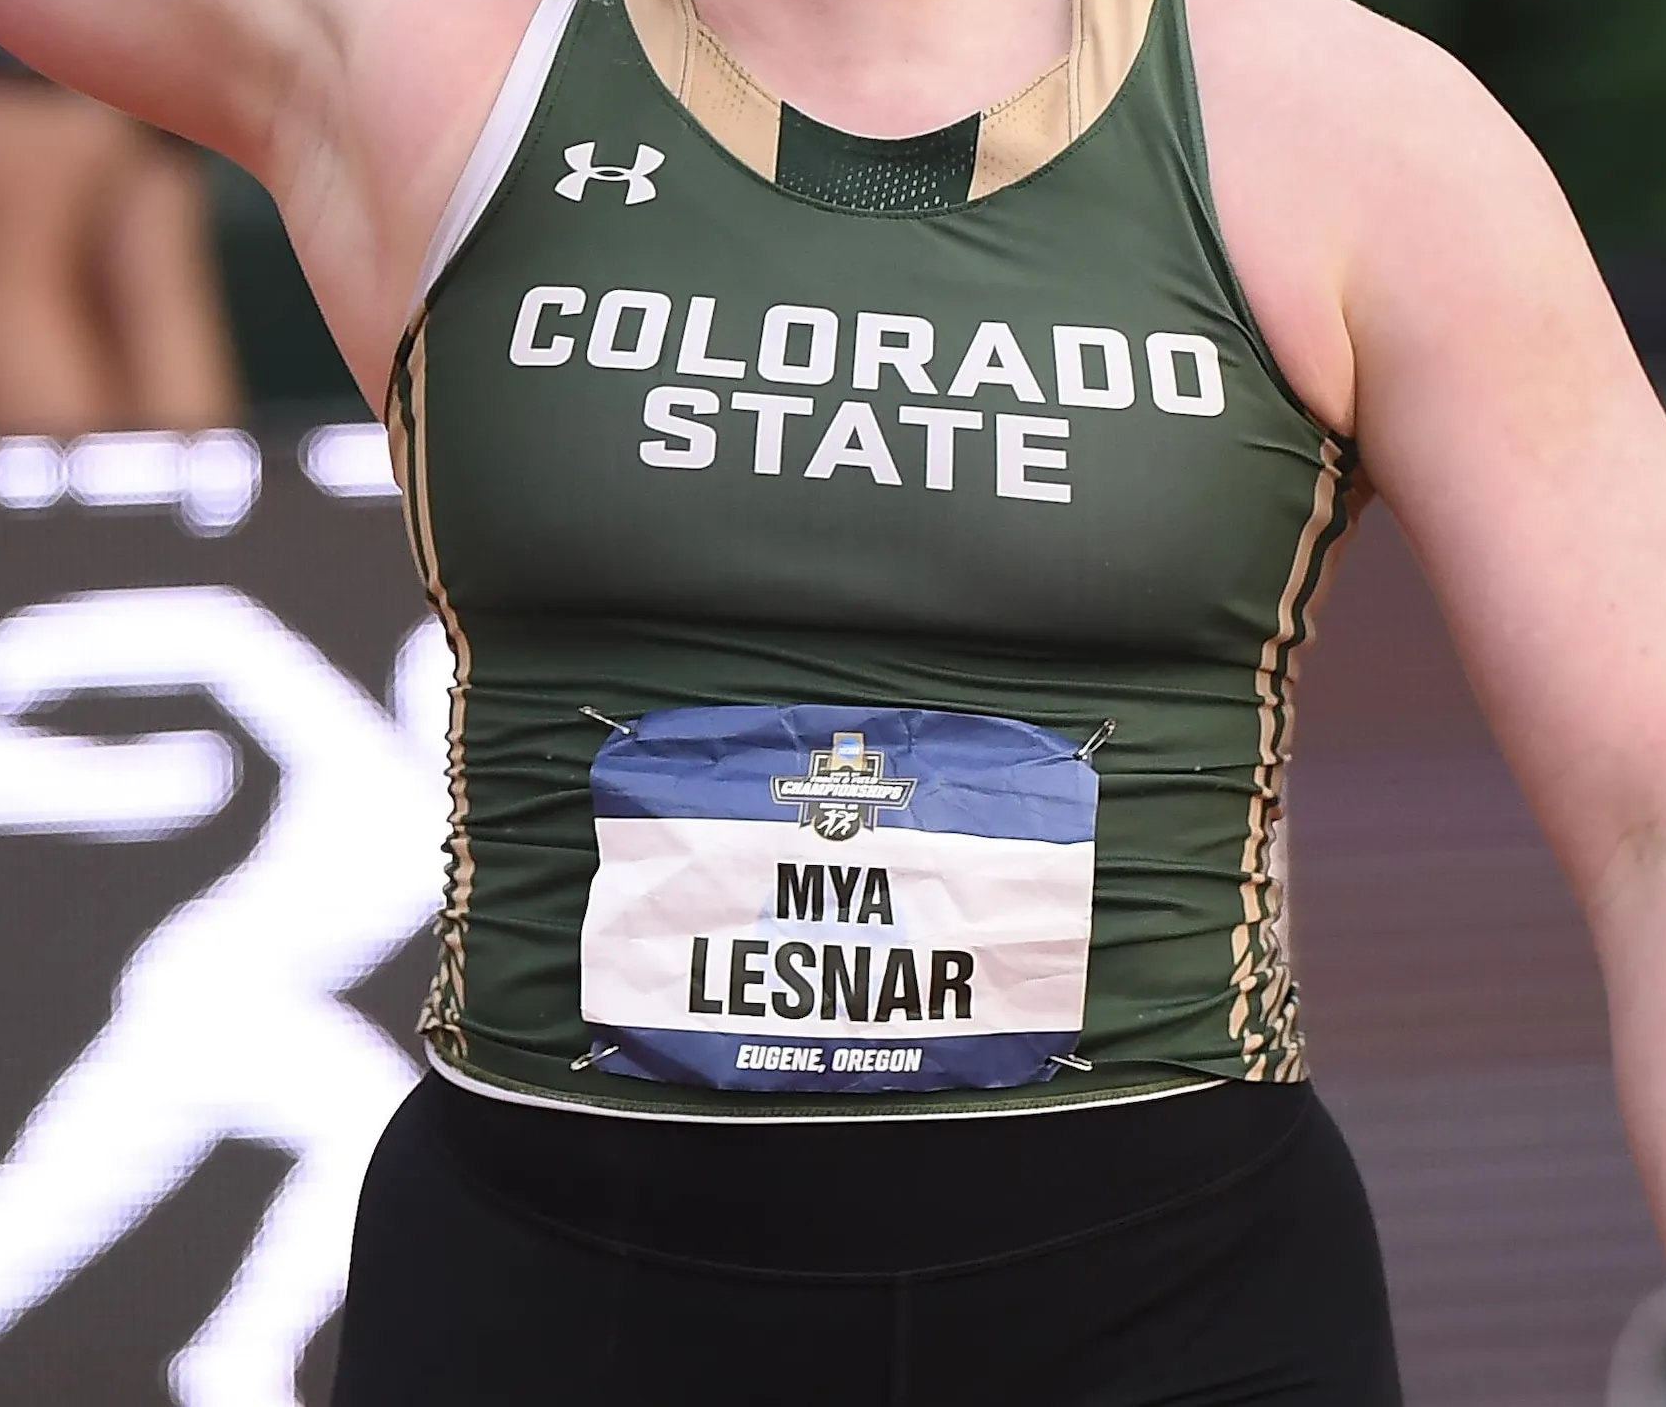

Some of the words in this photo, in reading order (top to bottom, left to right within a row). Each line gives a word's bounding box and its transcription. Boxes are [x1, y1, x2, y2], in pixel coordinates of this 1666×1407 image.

[508, 284, 1226, 418] COLORADO
[639, 386, 1072, 504] STATE
[780, 781, 903, 799] CHAMPIONSHIPS
[776, 862, 894, 925] MYA
[689, 937, 974, 1022] LESNAR
[736, 1045, 827, 1073] EUGENE,
[833, 1049, 922, 1072] OREGON
